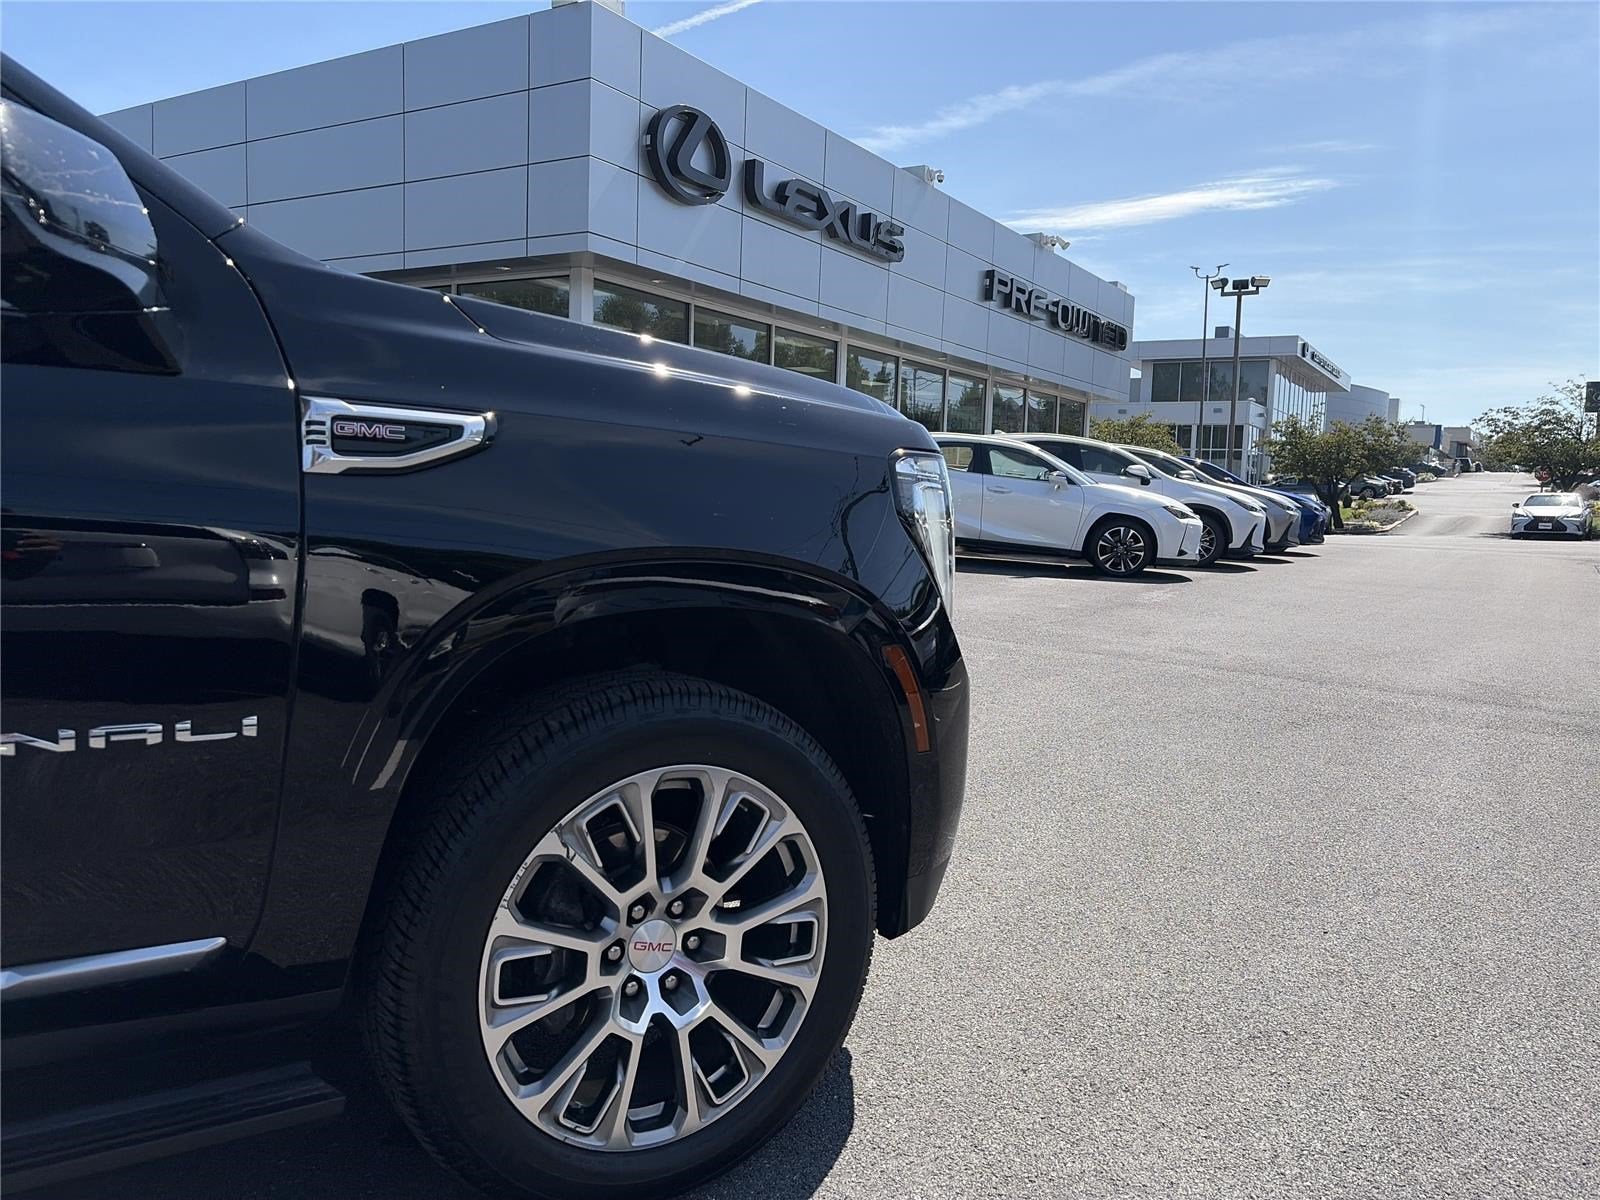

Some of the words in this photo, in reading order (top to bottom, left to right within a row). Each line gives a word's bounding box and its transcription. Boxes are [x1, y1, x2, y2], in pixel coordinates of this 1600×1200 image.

[744, 159, 905, 263] LEXUS
[984, 269, 1128, 351] PRE-OWNED
[333, 421, 406, 440] GMC
[633, 941, 673, 953] GMC
